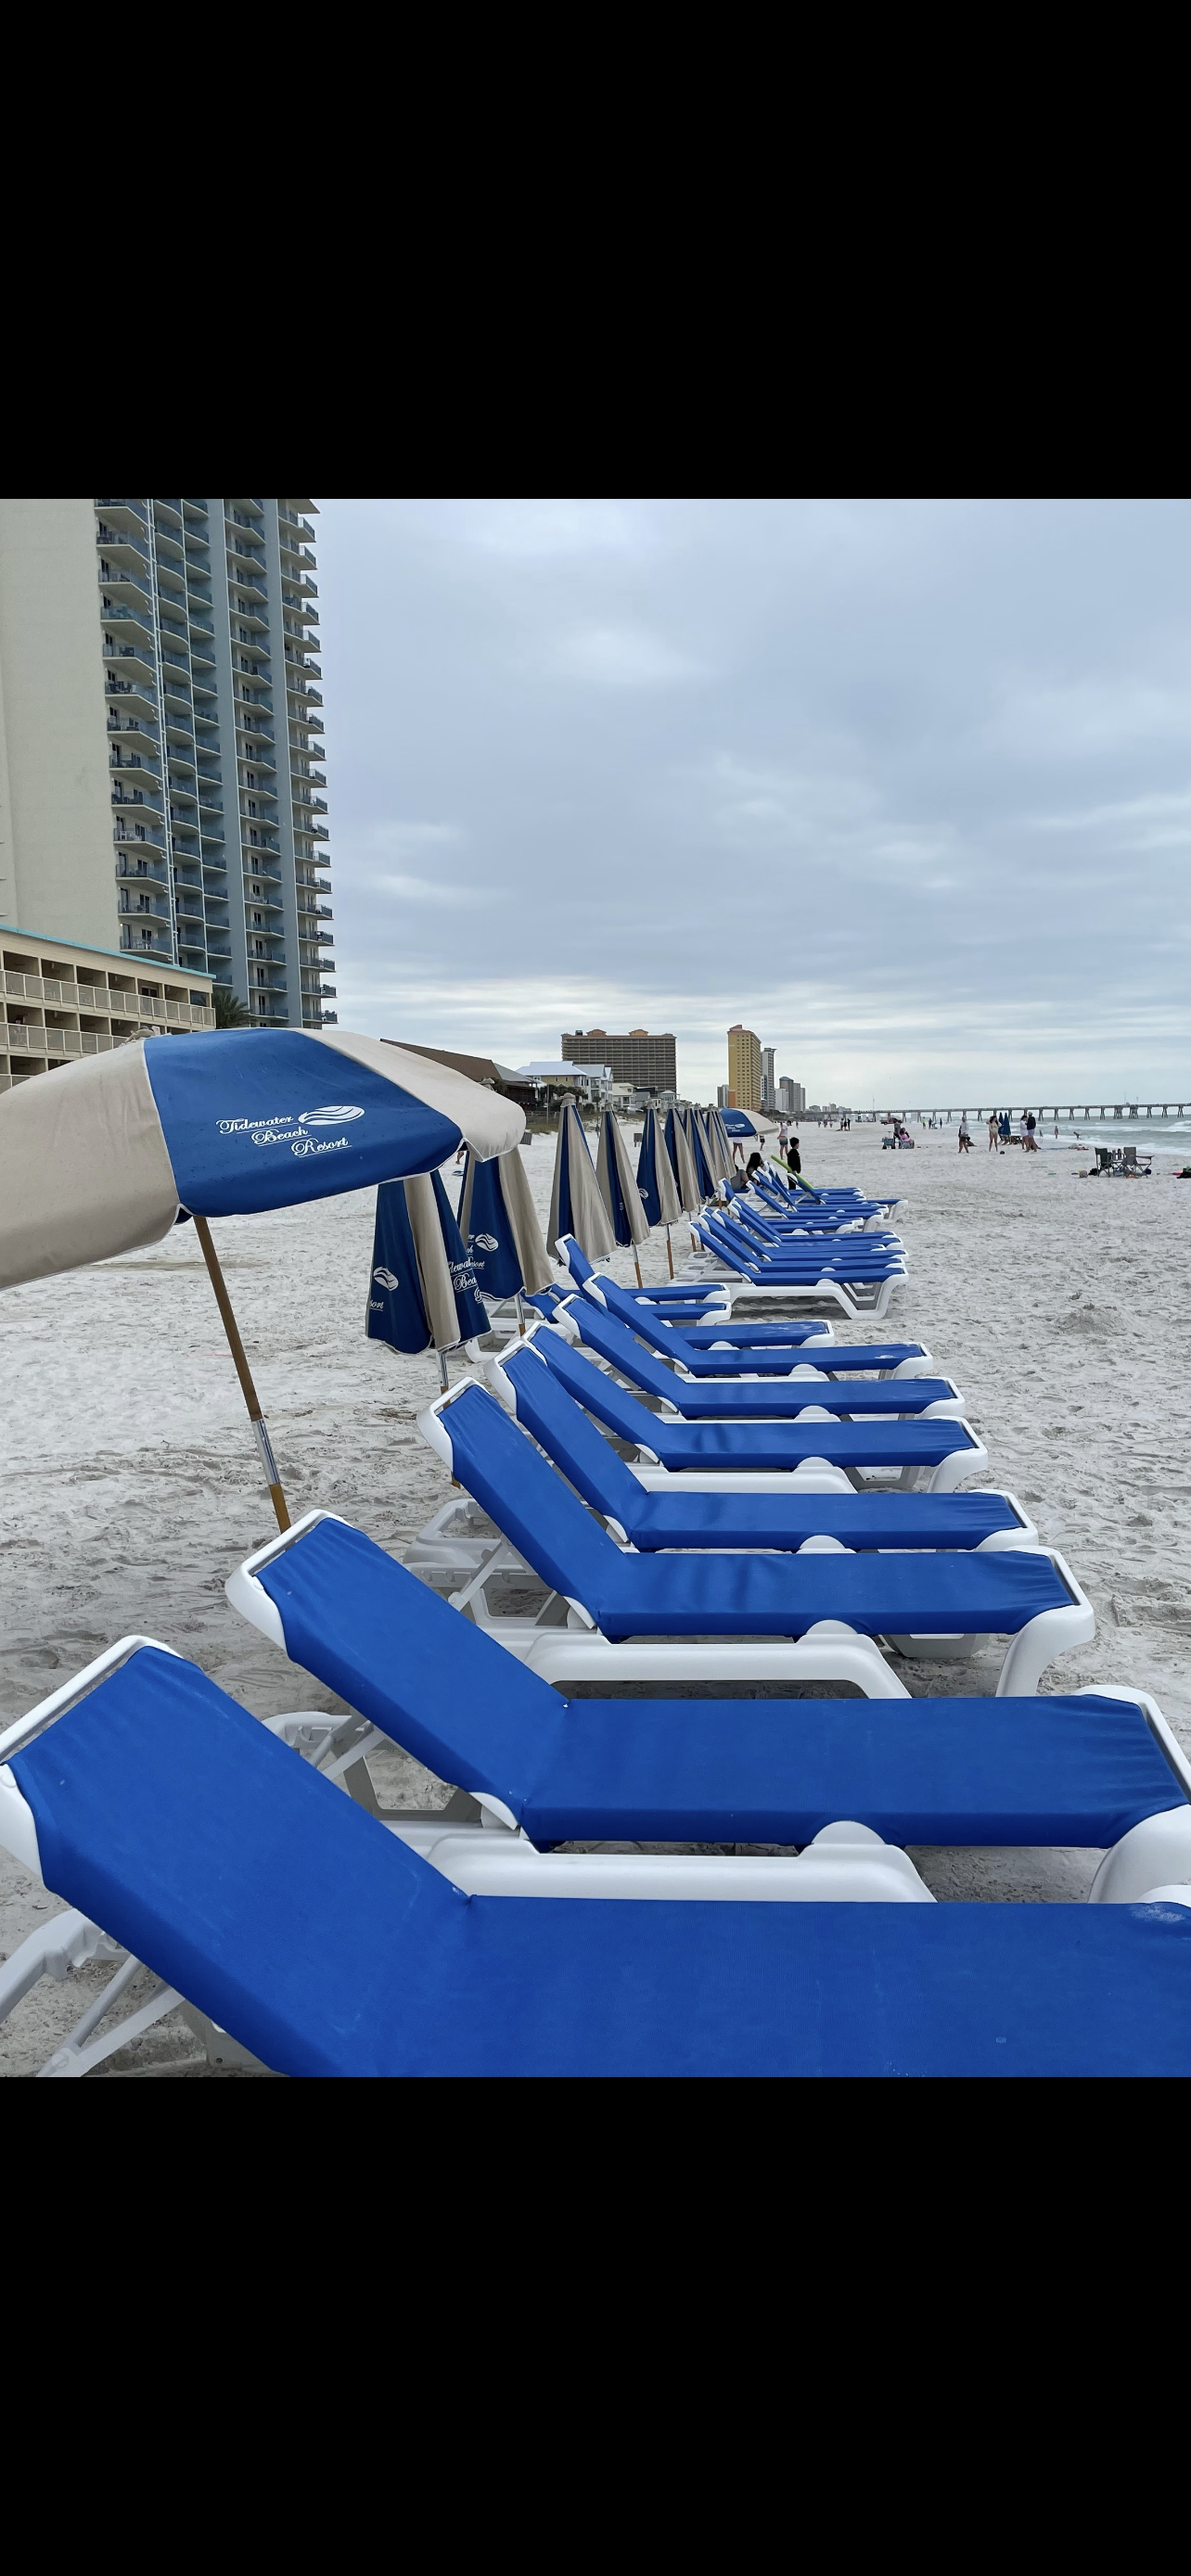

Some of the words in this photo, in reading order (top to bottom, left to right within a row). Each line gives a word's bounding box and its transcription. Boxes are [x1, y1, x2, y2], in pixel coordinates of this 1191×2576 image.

[215, 1116, 294, 1135] Tidewater
[251, 1127, 308, 1145] Beach
[290, 1137, 349, 1156] Resort
